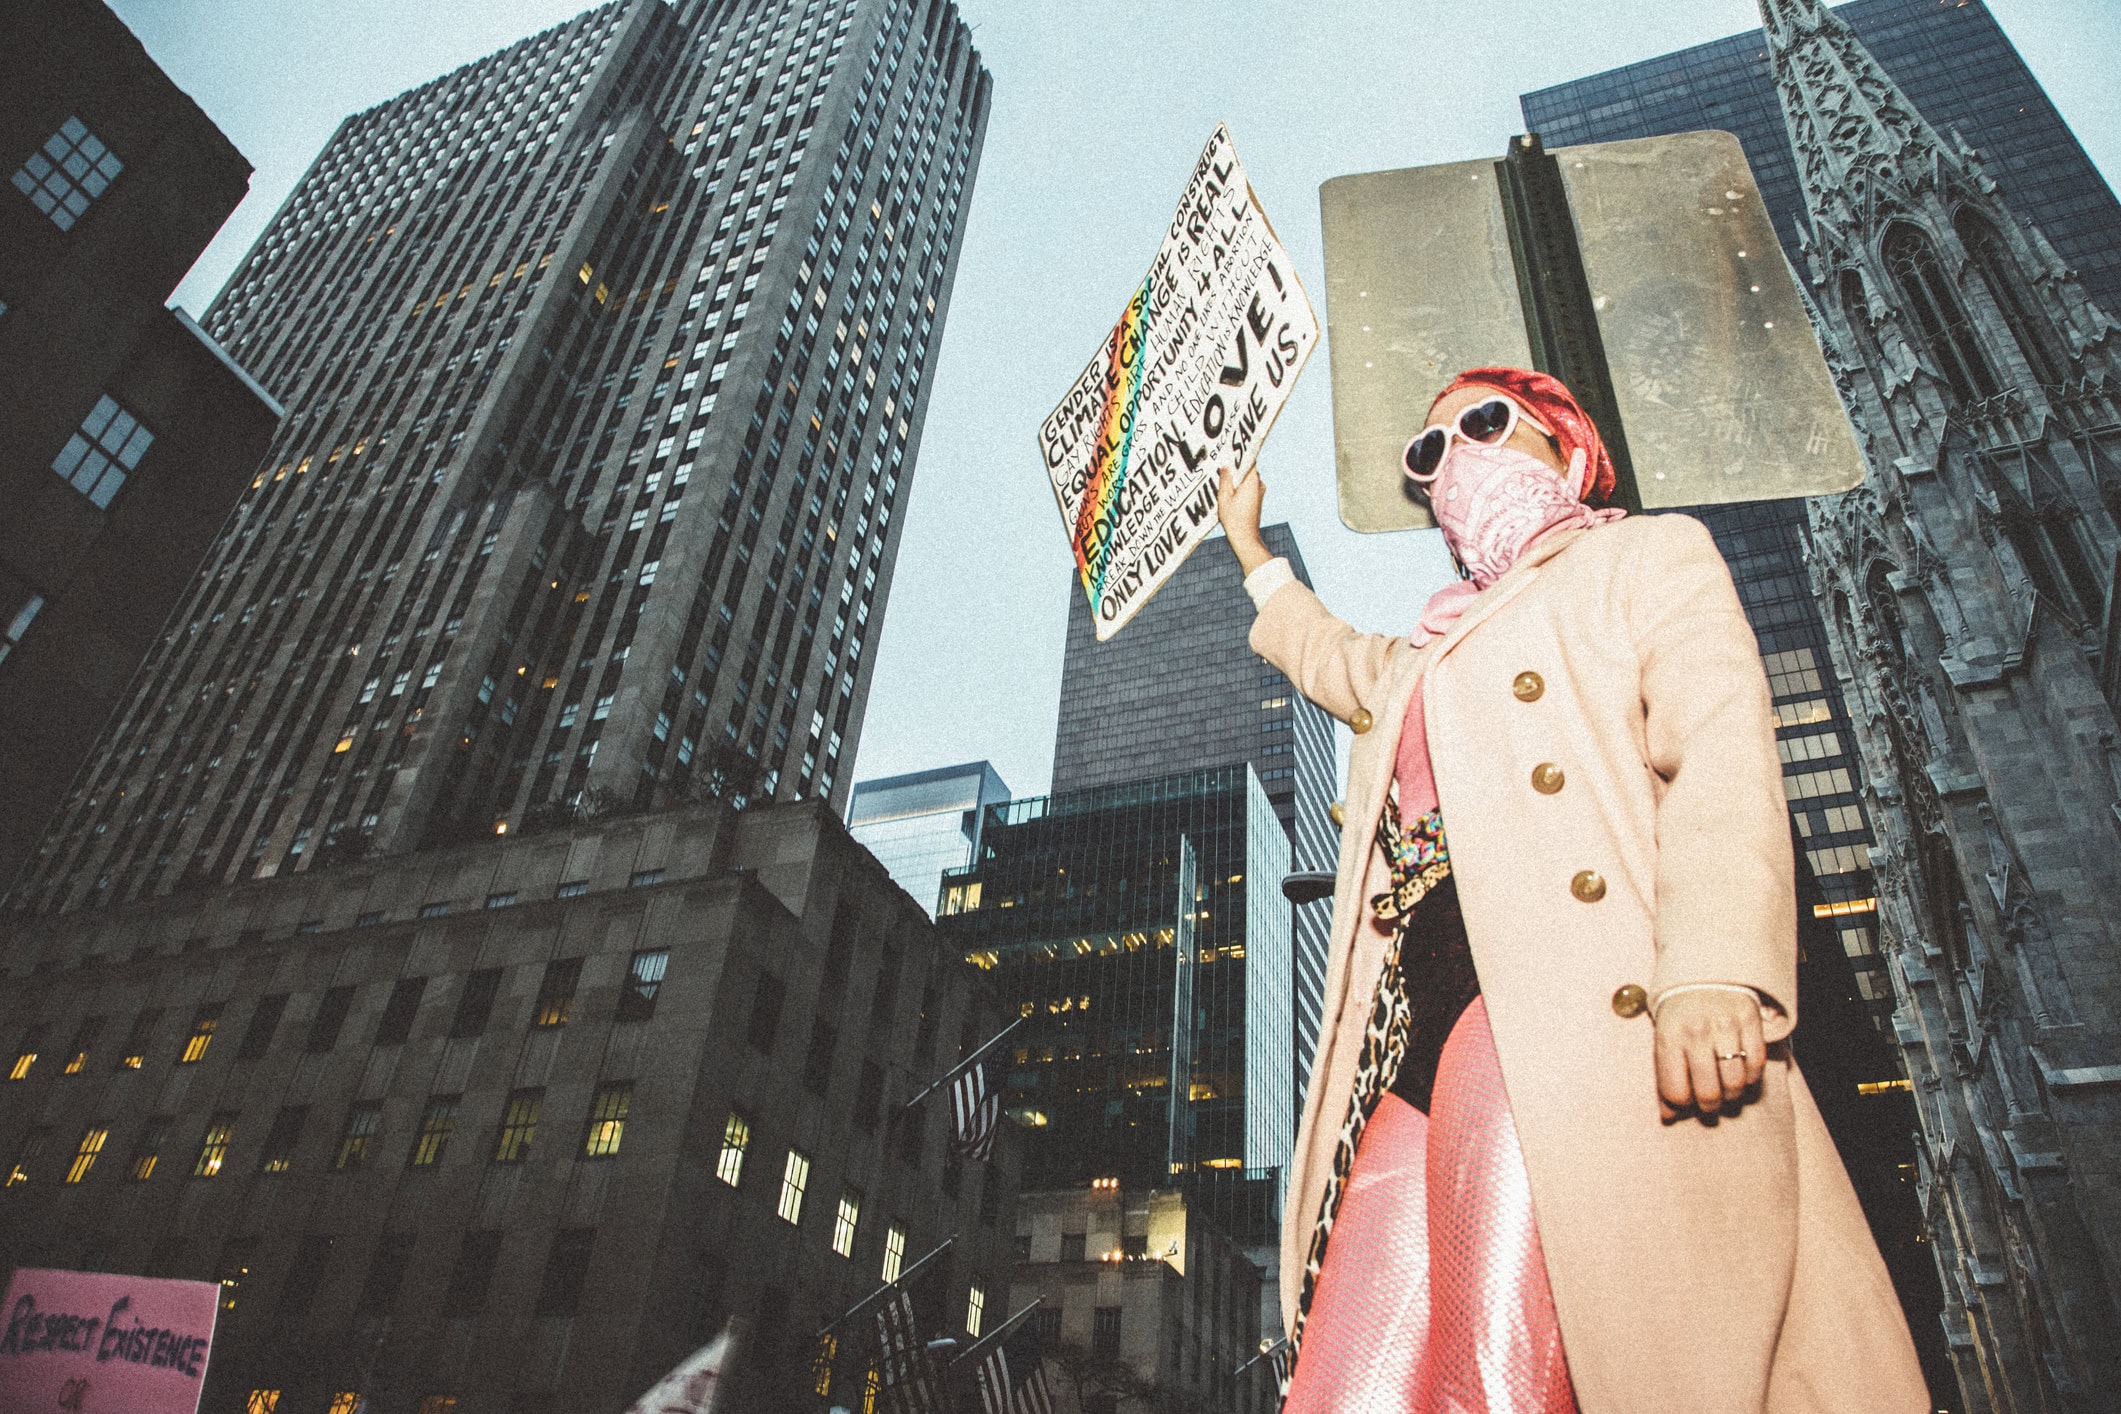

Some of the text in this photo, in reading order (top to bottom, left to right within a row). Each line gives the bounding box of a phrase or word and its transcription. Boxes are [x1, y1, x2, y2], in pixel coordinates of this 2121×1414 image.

[1045, 127, 1224, 442] GENDER IS A SOCIAL CONSTRUCT
[1048, 161, 1233, 468] CLIMATE CHANGE IS REAL
[1056, 186, 1234, 486] GAY RIGHTS ARE HUMAN RIGHTS
[1061, 201, 1247, 509] EQUAL OPPORTUNITY 4 ALL
[1068, 485, 1099, 525] GUNS
[1101, 459, 1120, 488] ARE
[1152, 382, 1173, 415] AND
[1175, 360, 1188, 380] NO
[1188, 329, 1201, 358] ONE
[1200, 290, 1216, 326] LIKES
[1219, 212, 1252, 286] ABORTION
[1076, 230, 1256, 537] BUT WORSE IS A CHILD WITHOUT
[1182, 335, 1226, 425] EDUCATION
[1228, 232, 1273, 329] KNOWLEDGE
[1085, 485, 1160, 588] KNOWLEDGE
[1160, 463, 1176, 489] IS
[1096, 400, 1240, 597] BREAK DOWN THE WALLS BECAUSE
[1101, 560, 1143, 621] ONLY
[1144, 515, 1188, 576] LOVE
[1232, 382, 1267, 470] SAVE
[1265, 322, 1306, 388] US.
[58, 1377, 91, 1410] OR
